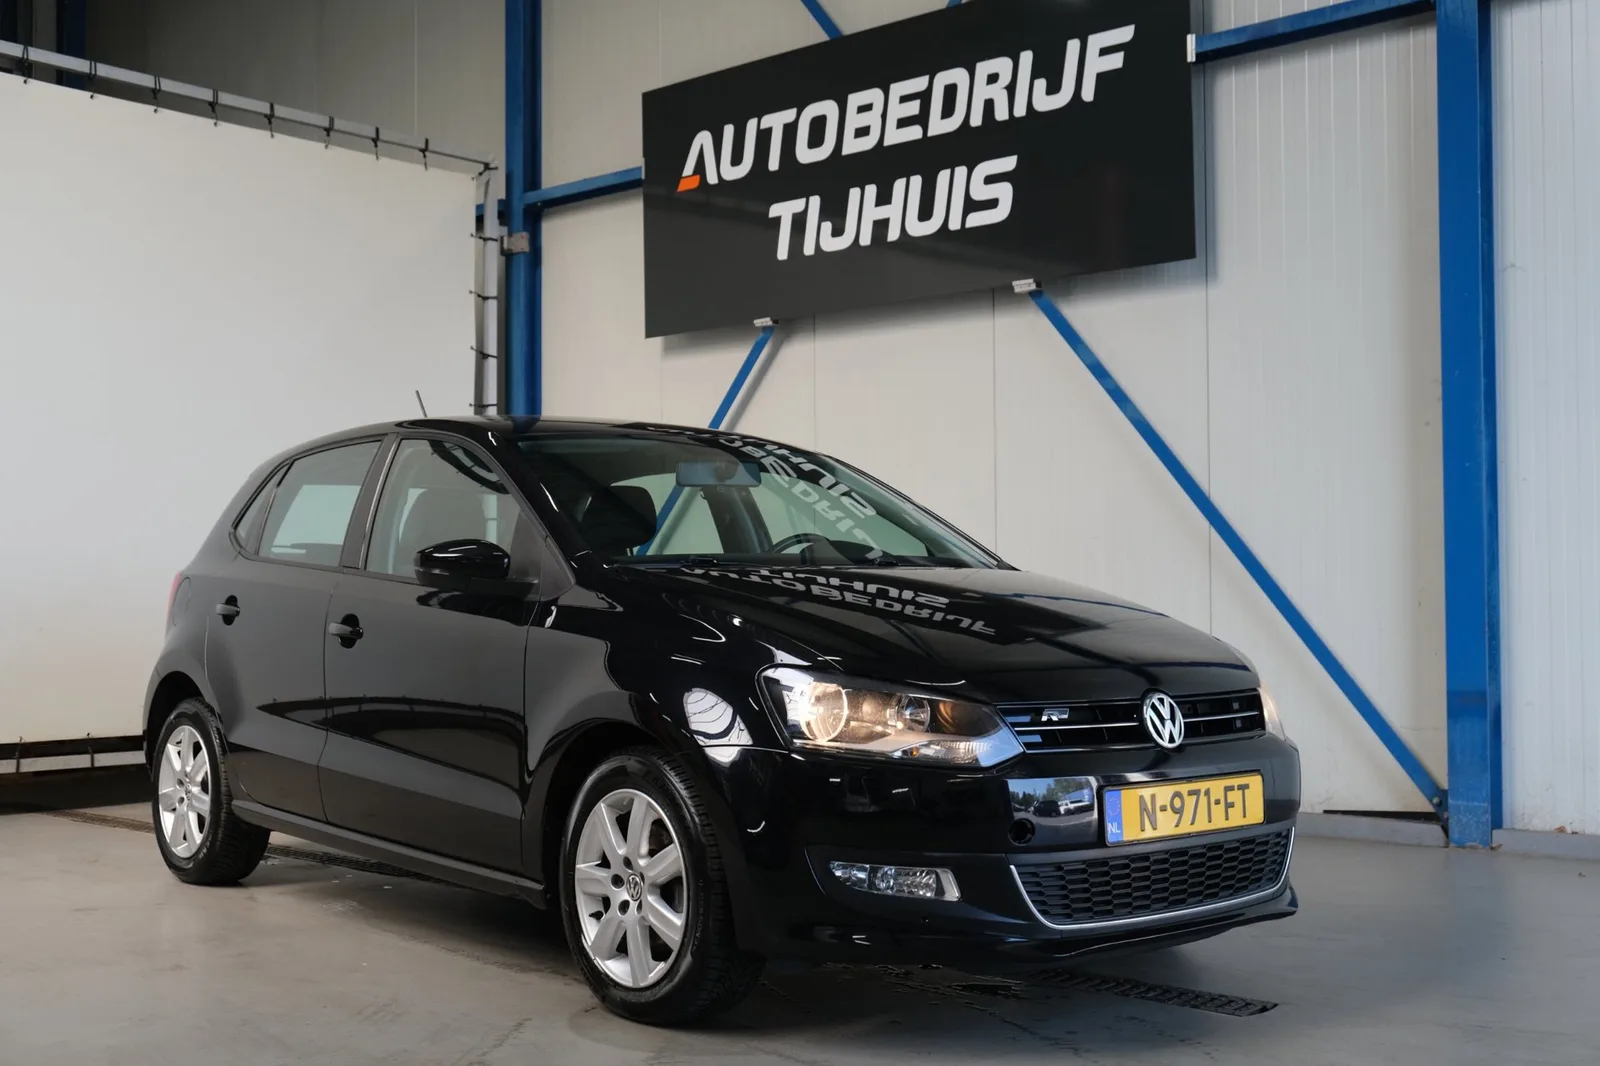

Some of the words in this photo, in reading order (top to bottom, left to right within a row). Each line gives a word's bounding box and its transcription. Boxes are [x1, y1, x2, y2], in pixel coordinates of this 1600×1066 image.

[676, 24, 1136, 193] AUTOBEDRIJF
[768, 154, 1018, 261] TIJHUIS
[1107, 821, 1121, 834] NL
[1139, 783, 1250, 832] N-971-FT
